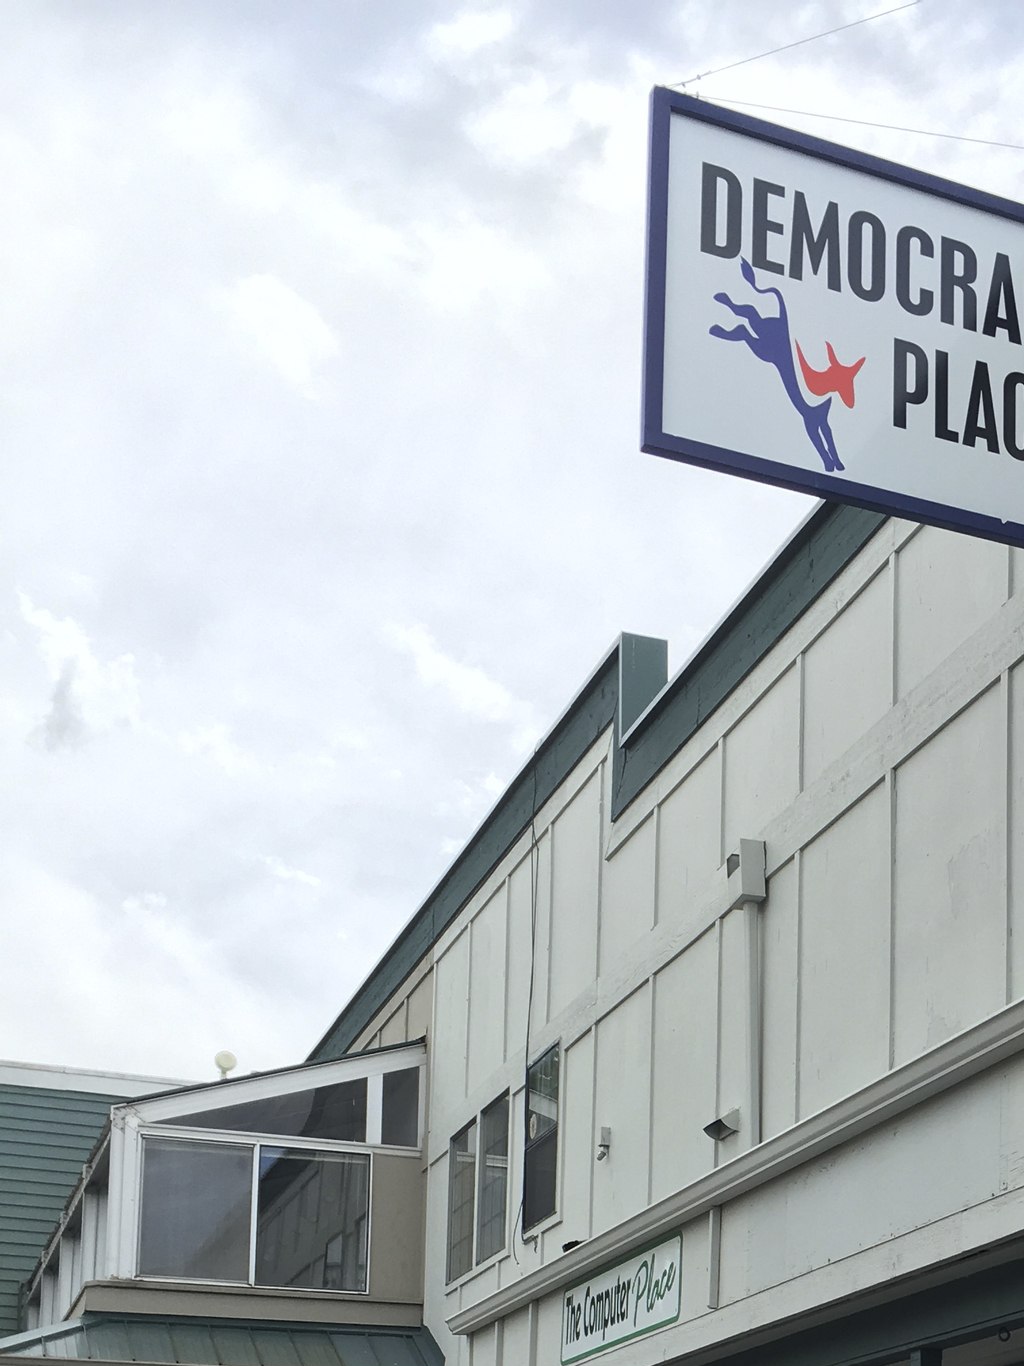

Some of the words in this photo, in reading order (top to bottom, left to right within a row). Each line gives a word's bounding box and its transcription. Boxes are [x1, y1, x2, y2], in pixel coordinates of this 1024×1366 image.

[566, 1294, 581, 1345] The
[584, 1275, 631, 1341] Computer
[632, 1253, 676, 1328] Place
